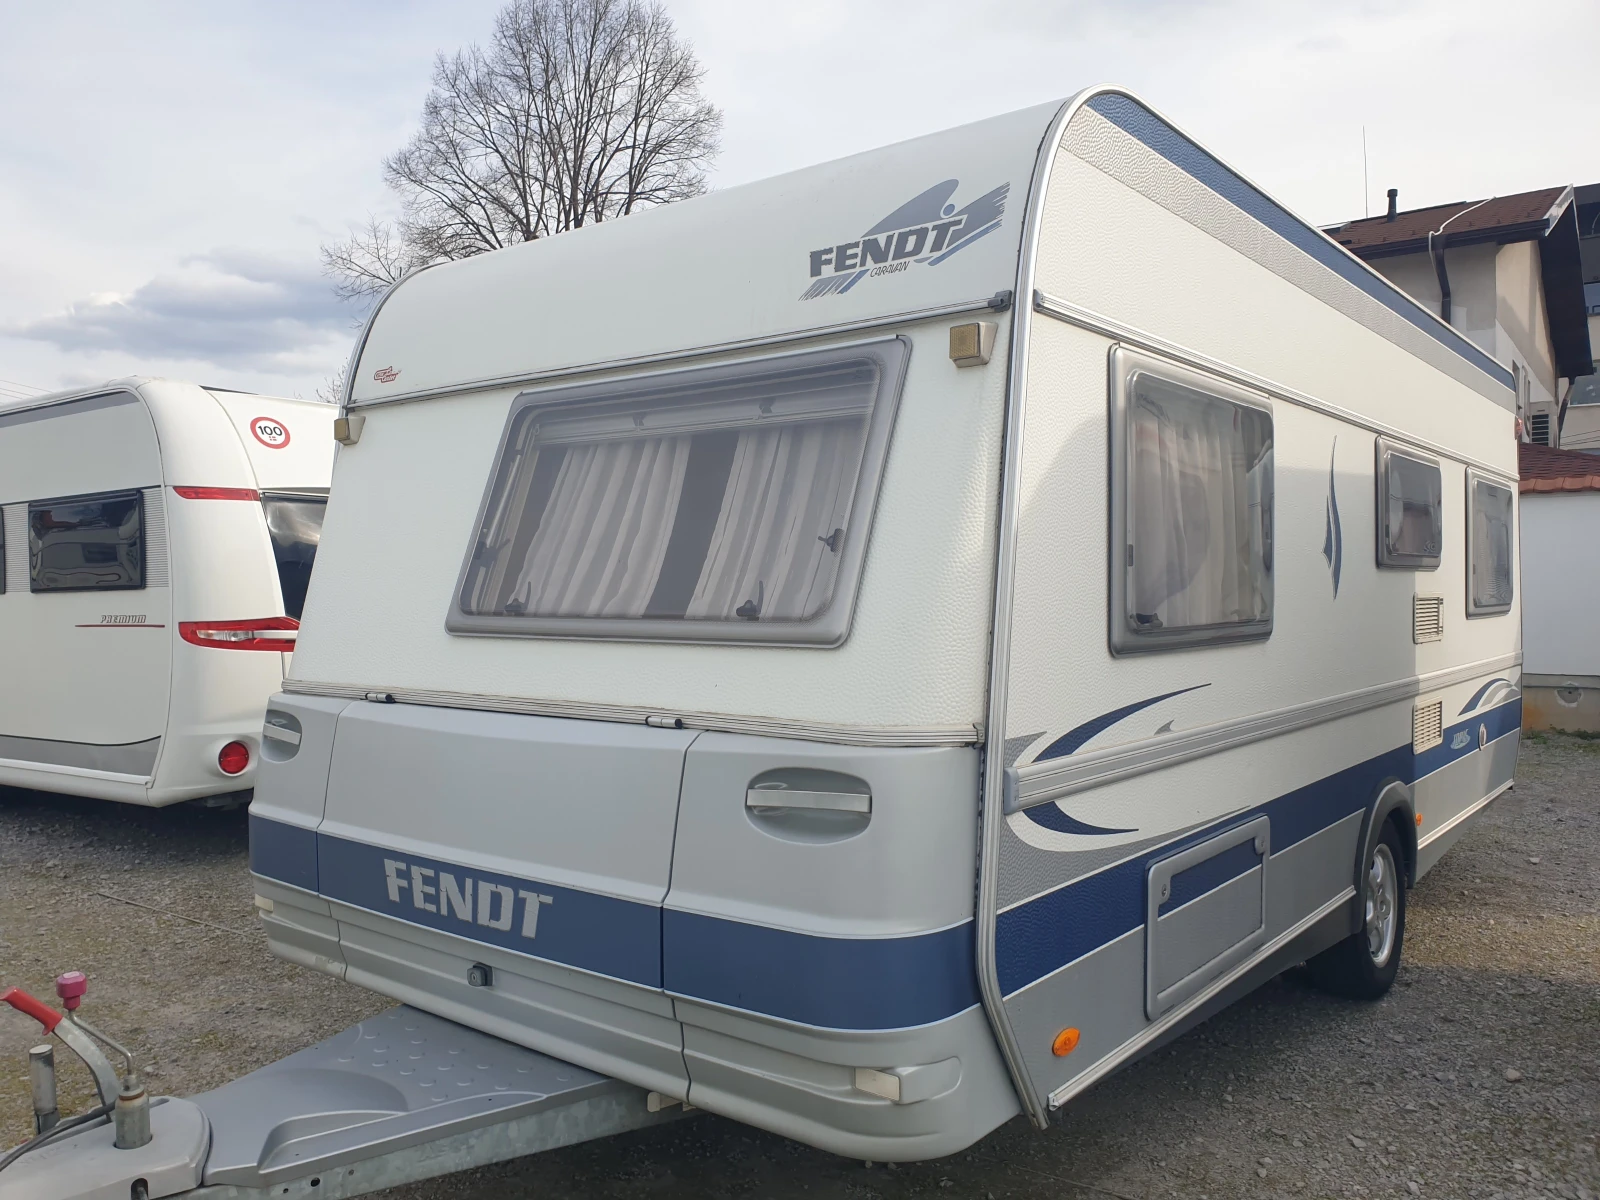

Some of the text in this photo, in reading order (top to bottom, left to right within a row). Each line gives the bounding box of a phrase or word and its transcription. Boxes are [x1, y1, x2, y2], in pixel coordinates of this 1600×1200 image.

[809, 218, 963, 277] FENDT
[870, 260, 910, 277] CARAVAN
[257, 425, 282, 436] 100
[100, 614, 146, 623] PREMIUM
[384, 859, 553, 939] FENDT
